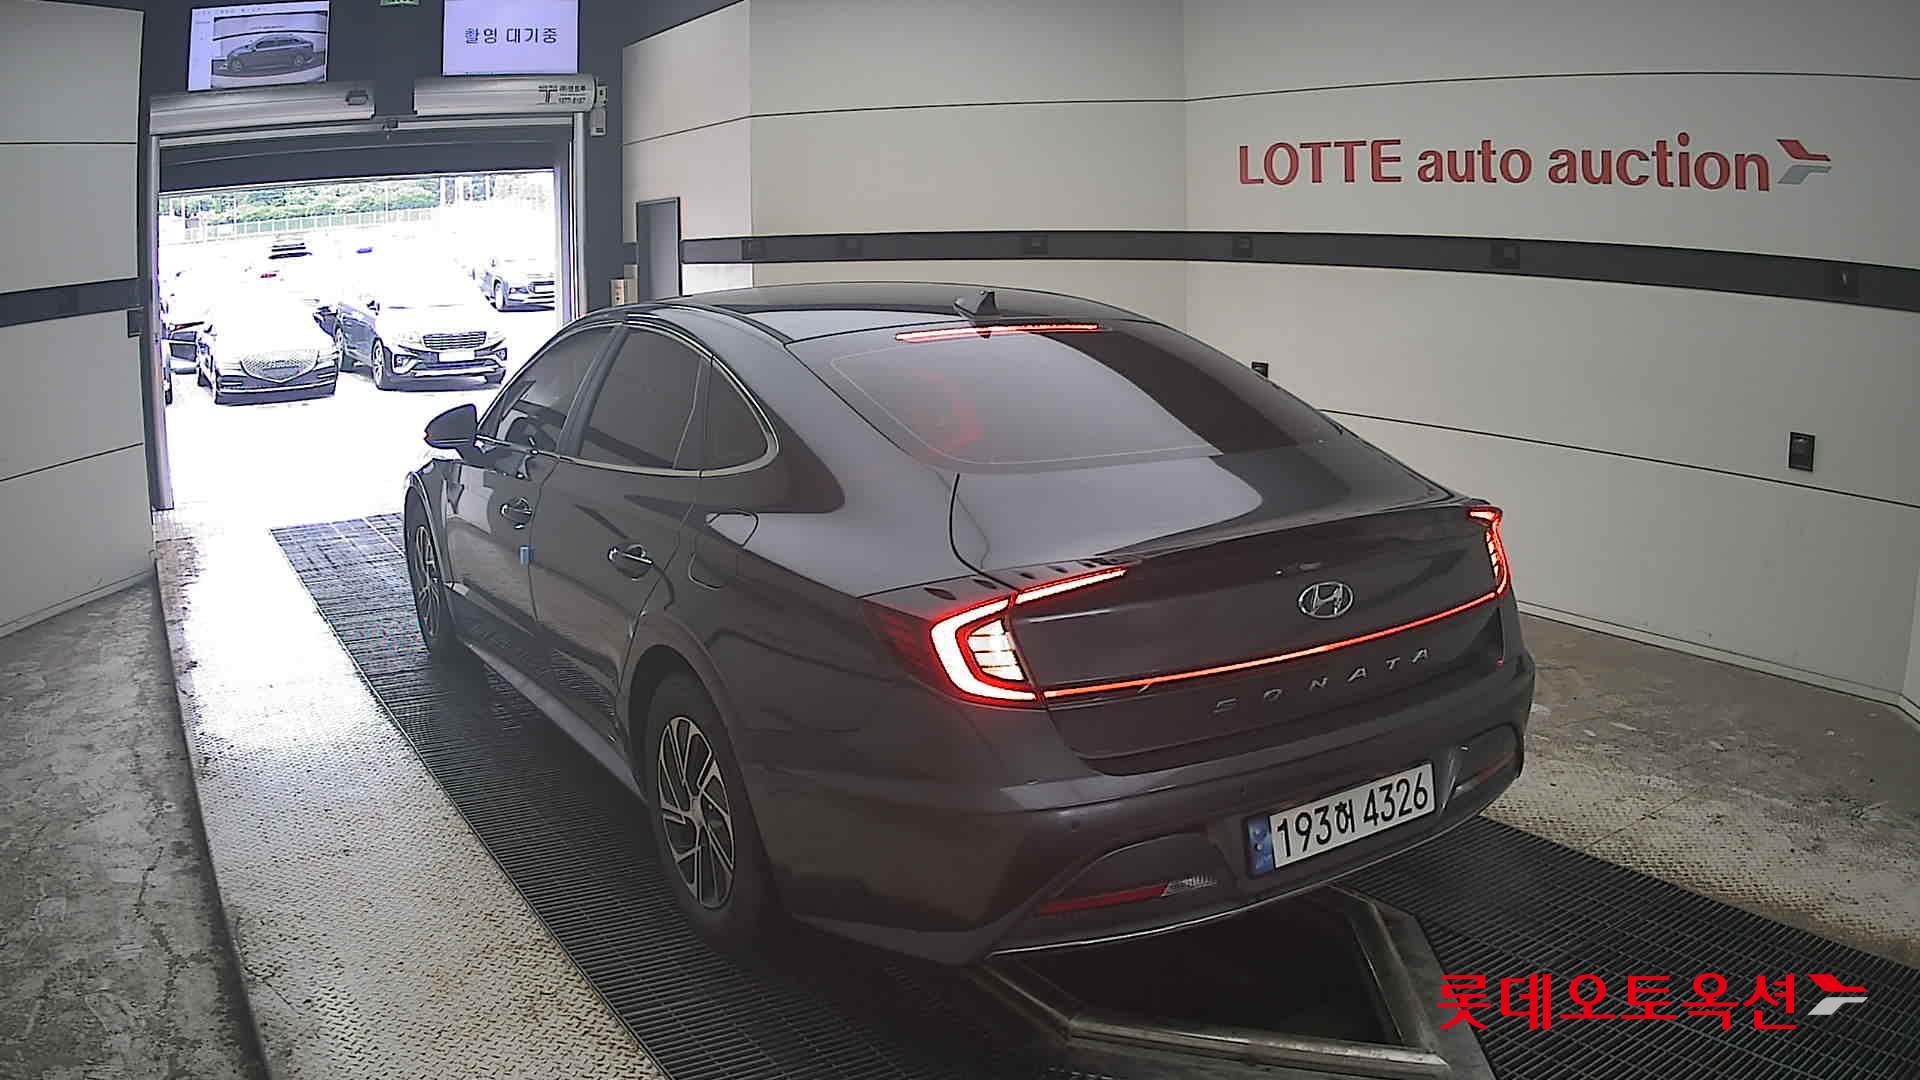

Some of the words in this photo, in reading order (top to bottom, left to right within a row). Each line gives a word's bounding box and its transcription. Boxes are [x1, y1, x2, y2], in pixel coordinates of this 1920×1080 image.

[1238, 139, 1402, 186] LOTTE
[1417, 140, 1533, 184] auto
[1547, 132, 1770, 192] auction
[1213, 648, 1429, 713] SONATA
[1363, 772, 1428, 827] 4326
